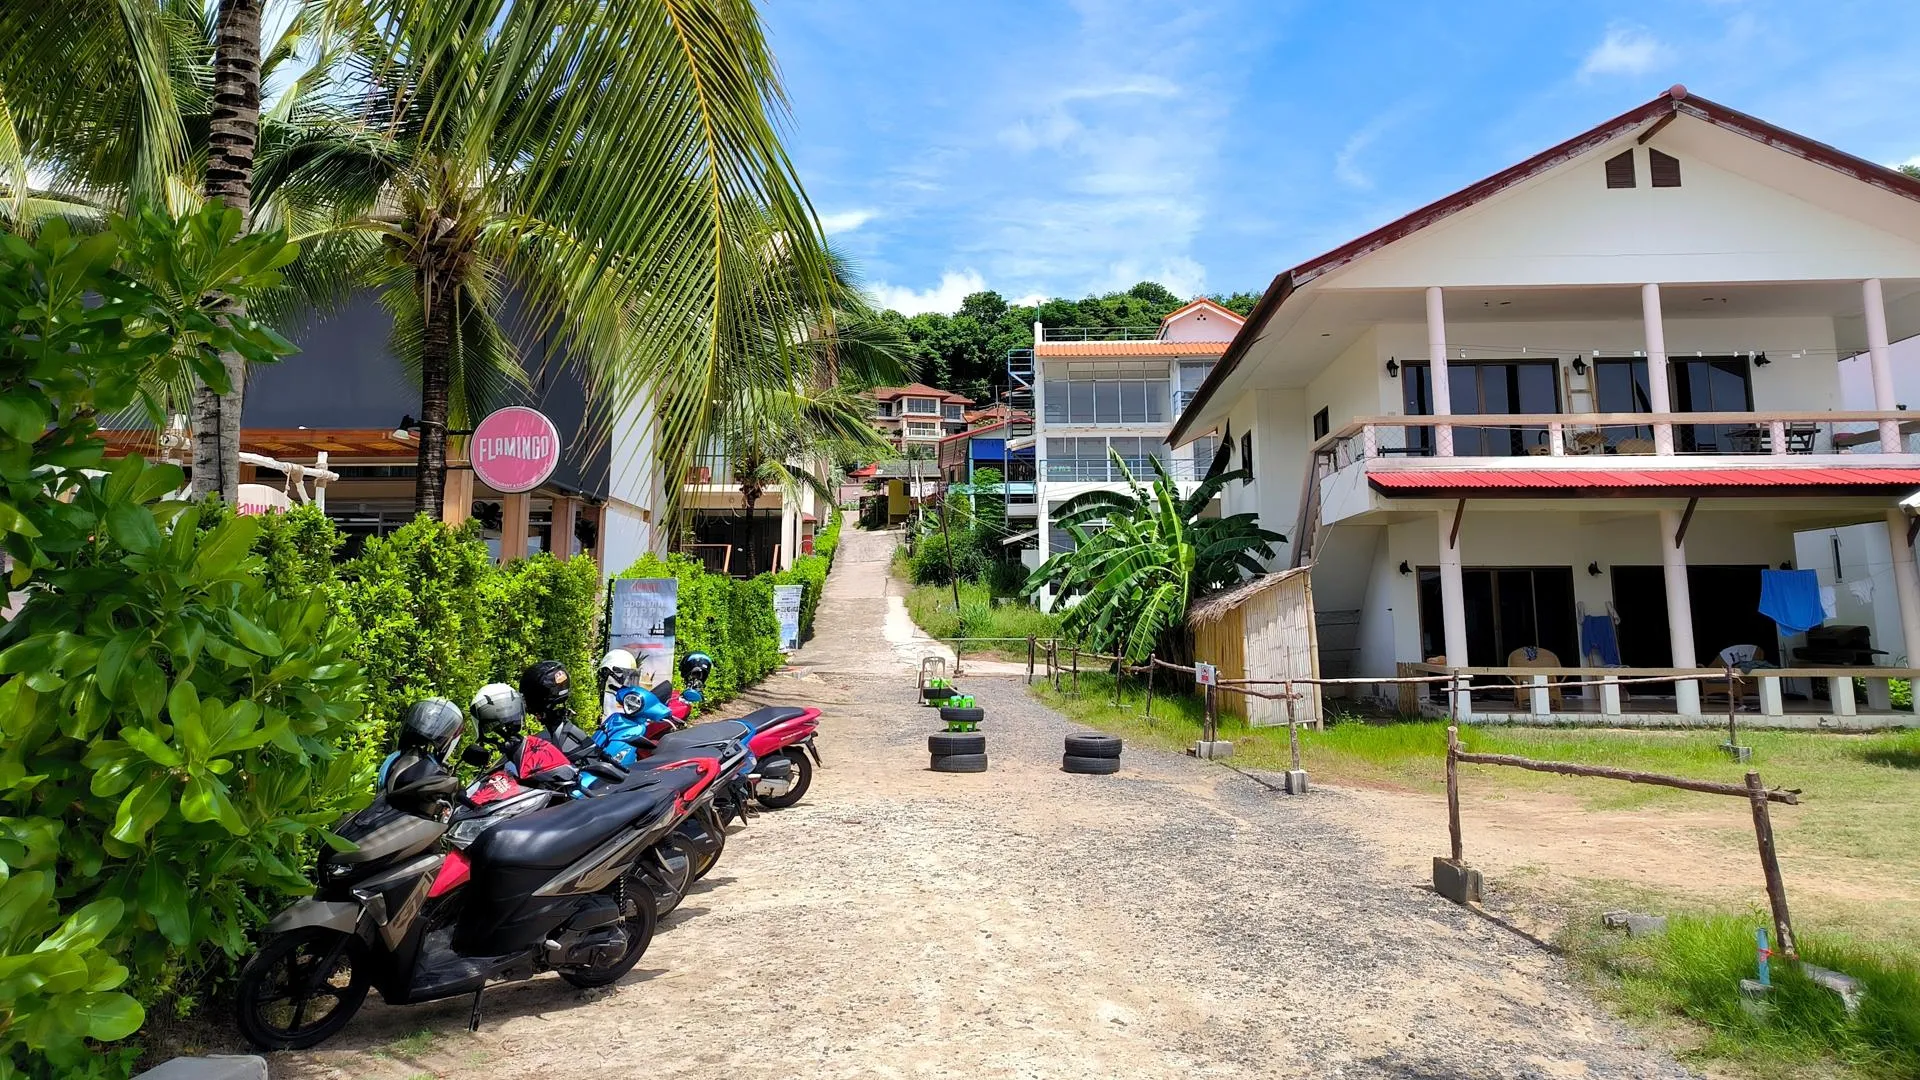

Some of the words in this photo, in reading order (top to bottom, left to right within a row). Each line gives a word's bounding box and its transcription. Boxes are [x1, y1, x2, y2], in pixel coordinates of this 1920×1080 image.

[479, 435, 549, 462] FLAMINGO
[623, 607, 666, 617] HAPPY
[623, 617, 665, 629] HOUR
